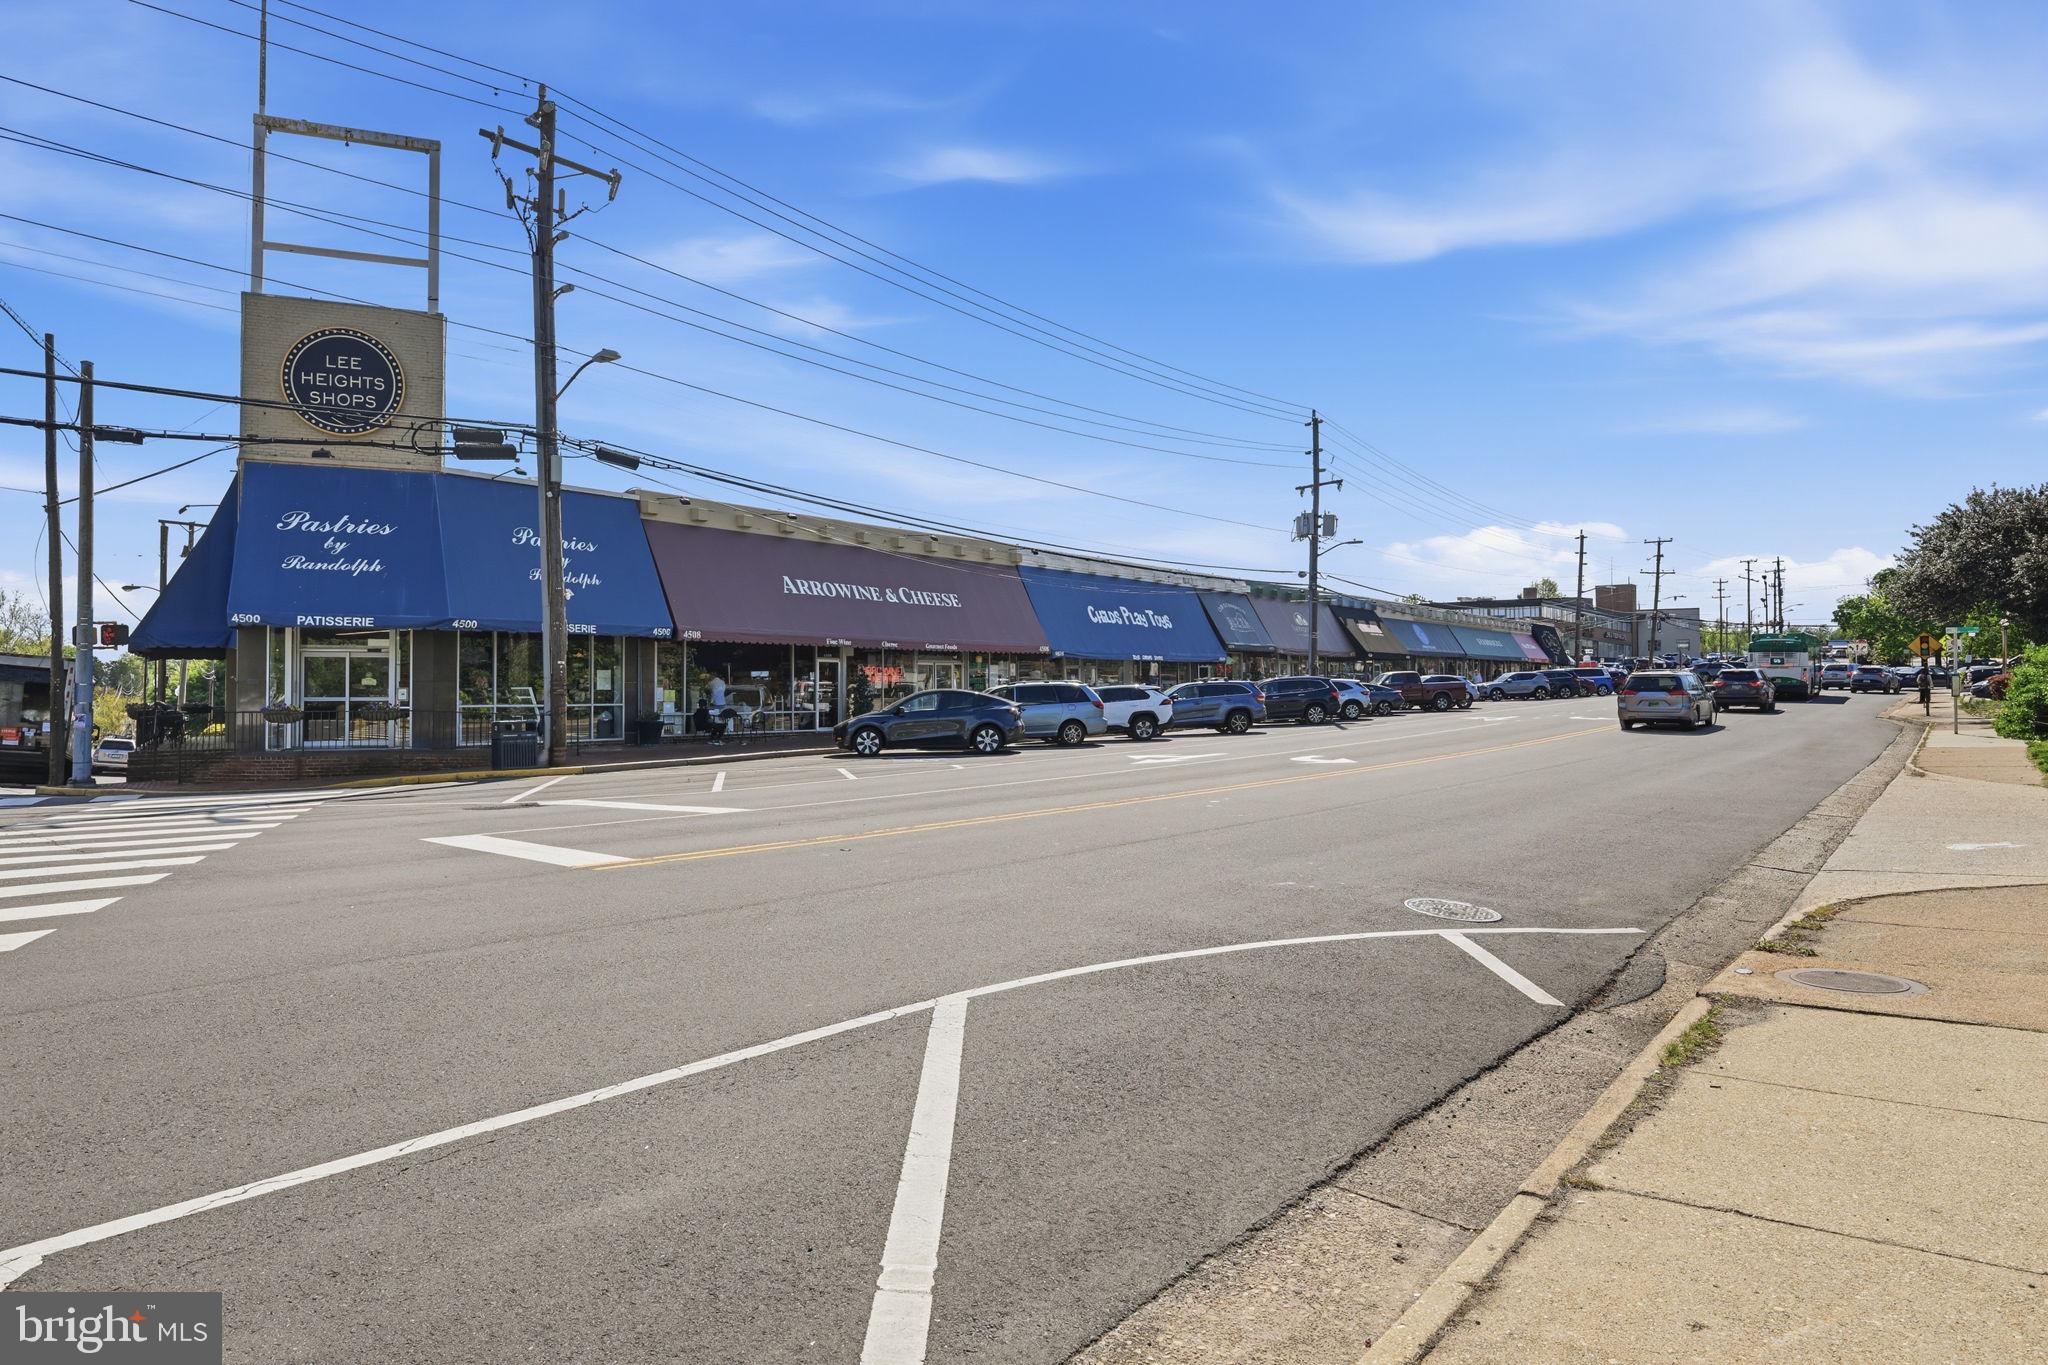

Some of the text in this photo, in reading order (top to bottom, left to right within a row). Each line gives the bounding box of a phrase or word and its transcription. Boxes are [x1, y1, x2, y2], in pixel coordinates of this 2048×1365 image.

[325, 355, 362, 370] LEE
[301, 371, 385, 391] HEIGHTS
[309, 390, 377, 408] SHOPS
[276, 510, 398, 535] Pastries
[323, 536, 350, 555] by
[511, 526, 599, 552] Paries
[281, 554, 386, 577] Randolph
[529, 567, 602, 589] Rdolph
[782, 575, 962, 608] ARROWINE & CHEESE
[231, 613, 261, 624] 4500
[296, 615, 375, 627] PATISSERIE
[452, 619, 478, 629] 4500
[683, 630, 702, 639] 4508
